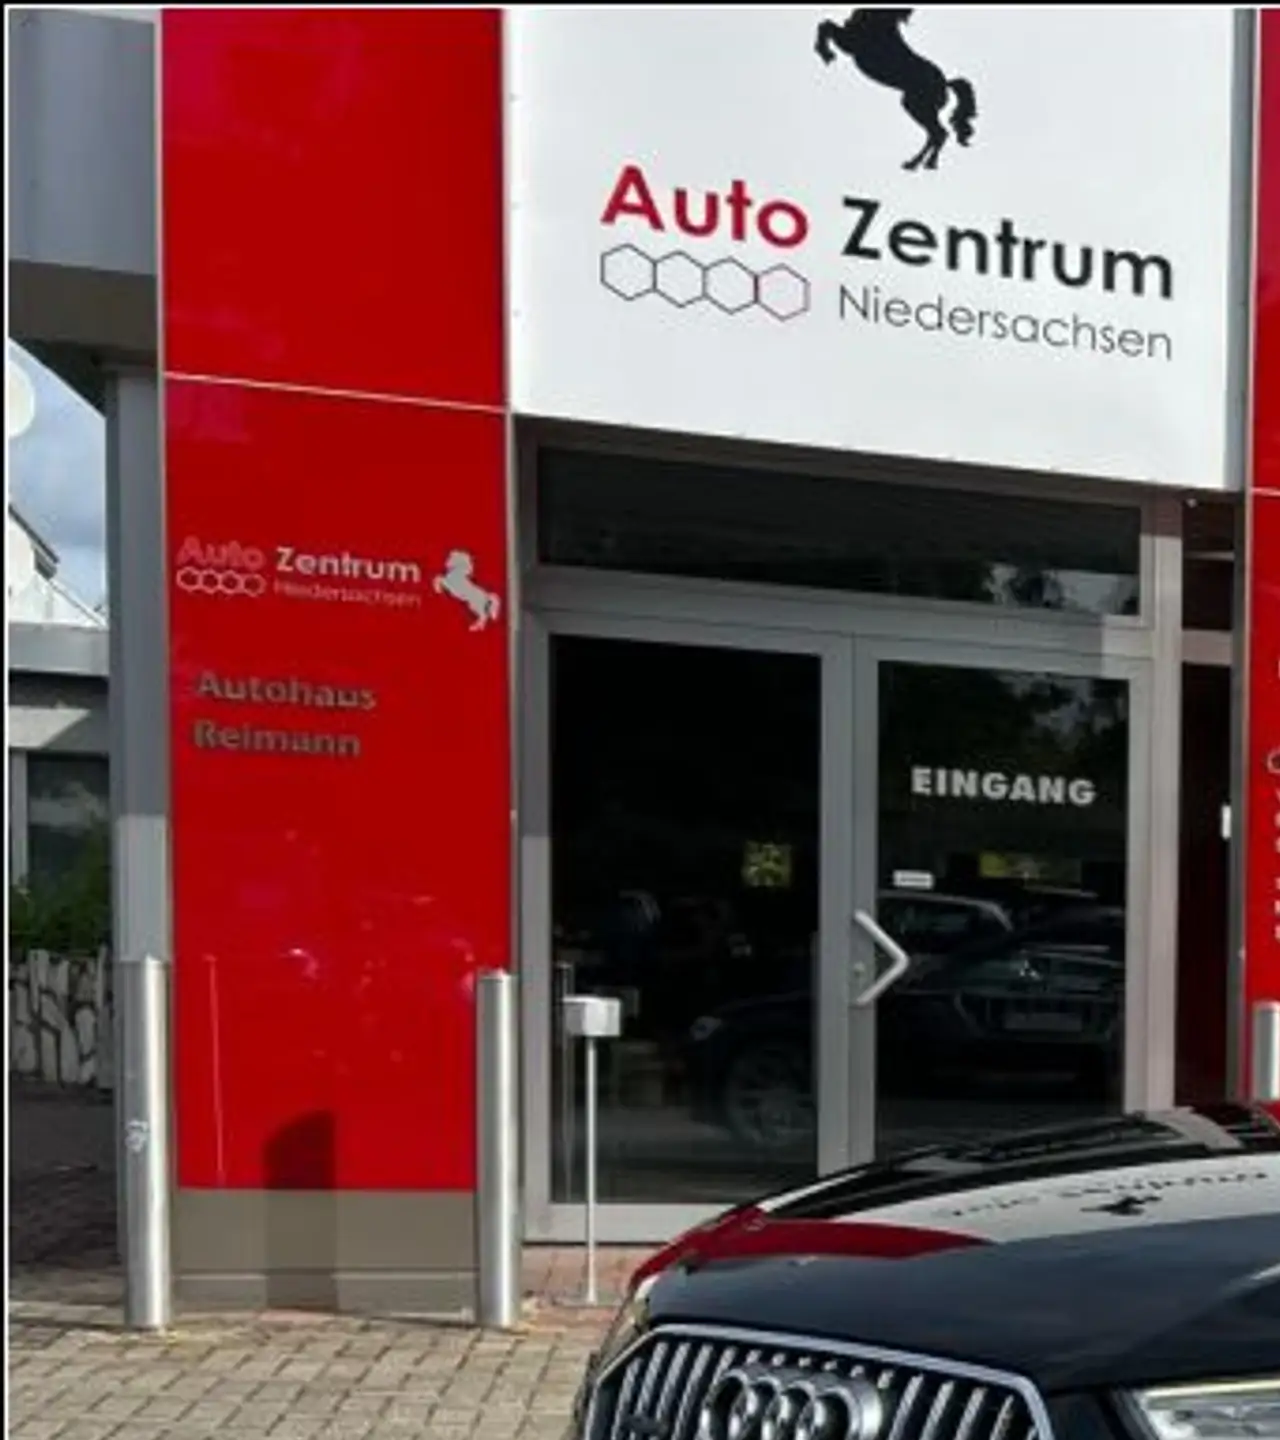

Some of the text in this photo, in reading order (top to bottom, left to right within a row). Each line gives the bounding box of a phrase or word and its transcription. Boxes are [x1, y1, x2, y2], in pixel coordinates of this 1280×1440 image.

[600, 165, 1173, 299] Auto Zentrum
[838, 285, 1173, 361] Niedersachsen
[178, 535, 421, 583] Auto Zentrum
[197, 671, 376, 710] Autohaus
[193, 719, 361, 757] Reimann
[911, 766, 1097, 805] EINGANG
